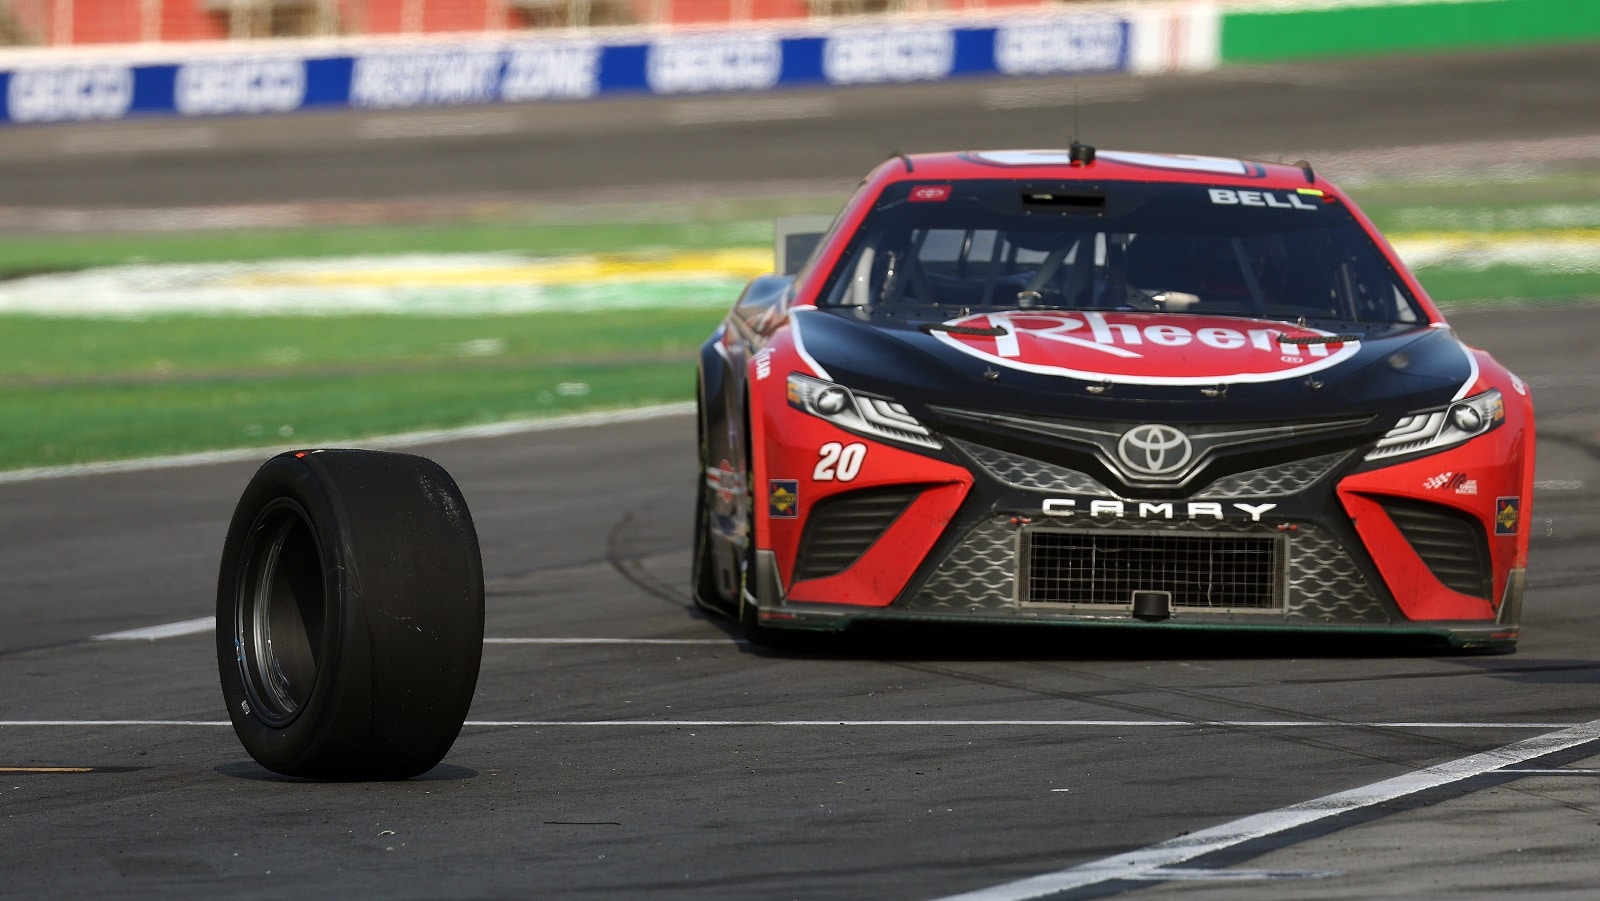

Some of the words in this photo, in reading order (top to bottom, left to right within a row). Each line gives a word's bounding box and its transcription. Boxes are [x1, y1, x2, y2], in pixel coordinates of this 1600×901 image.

[1208, 188, 1317, 210] BELL
[988, 311, 1329, 358] Rheem
[812, 441, 867, 482] 20
[1042, 498, 1277, 522] CAMRY
